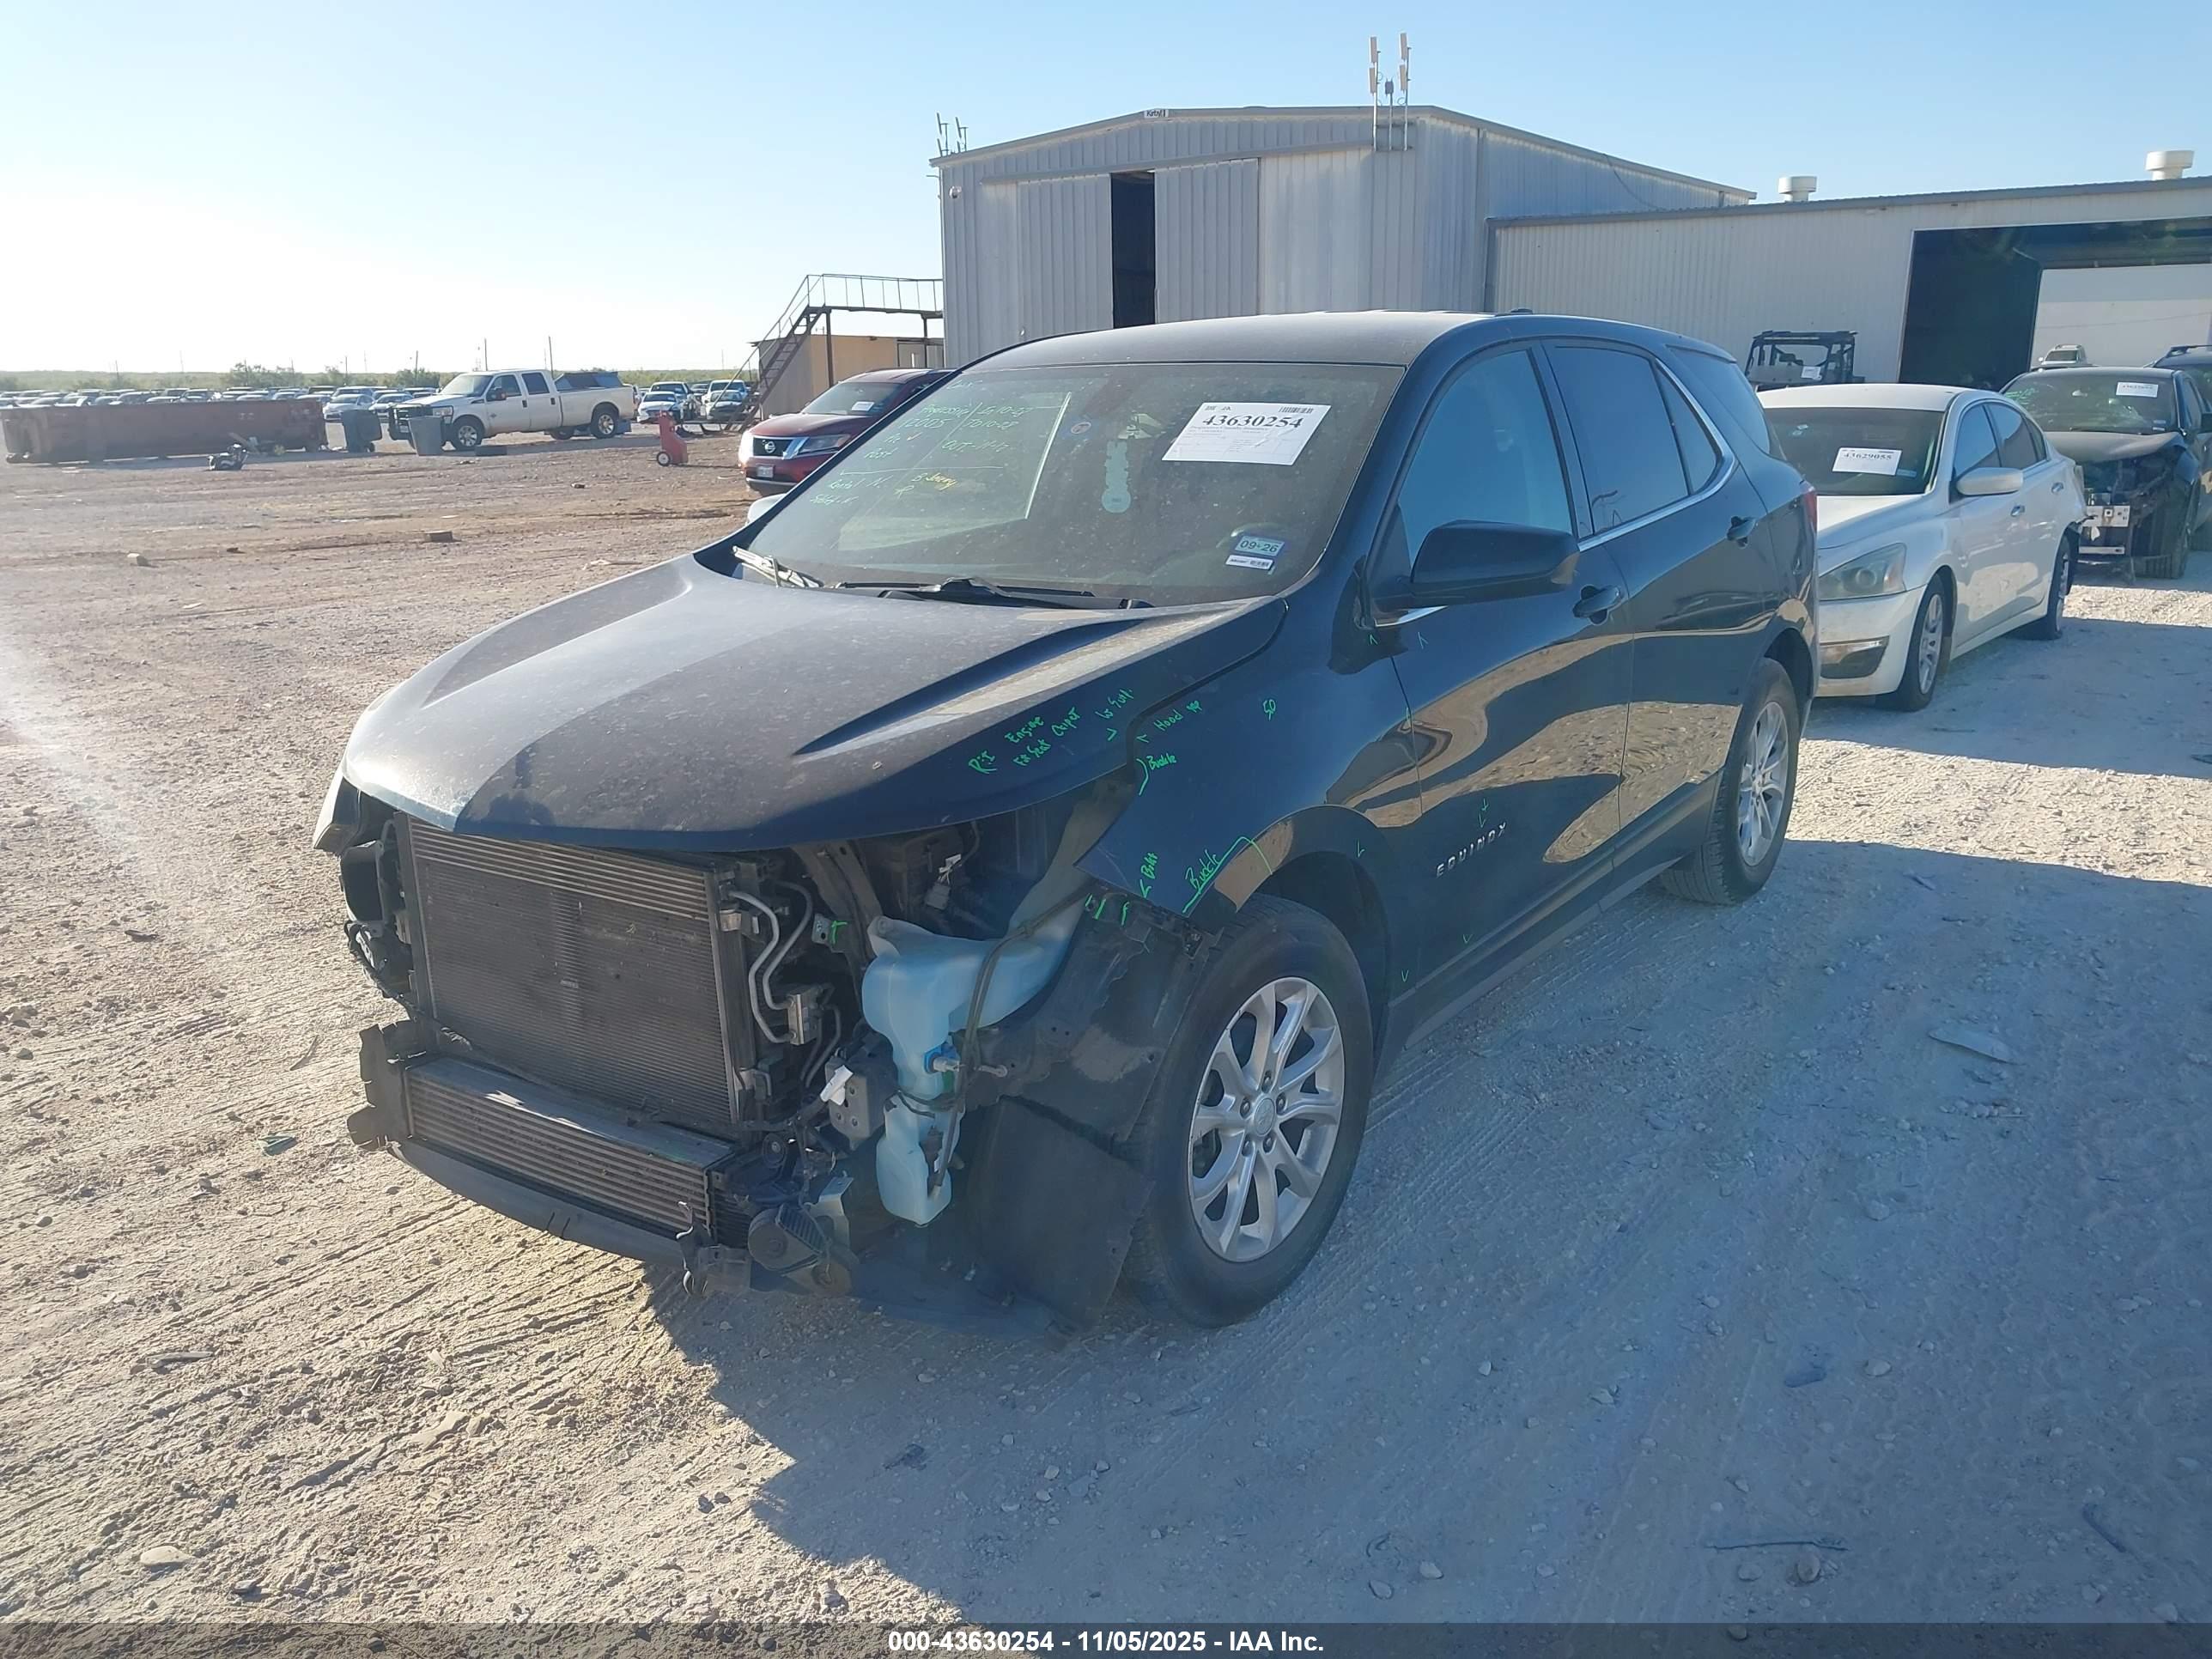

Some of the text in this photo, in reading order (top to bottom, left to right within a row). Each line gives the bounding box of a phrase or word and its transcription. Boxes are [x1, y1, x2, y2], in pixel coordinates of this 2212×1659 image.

[1202, 415, 1304, 428] 43630254
[1153, 708, 1184, 732] Hood
[1437, 822, 1506, 878] EQUINOX
